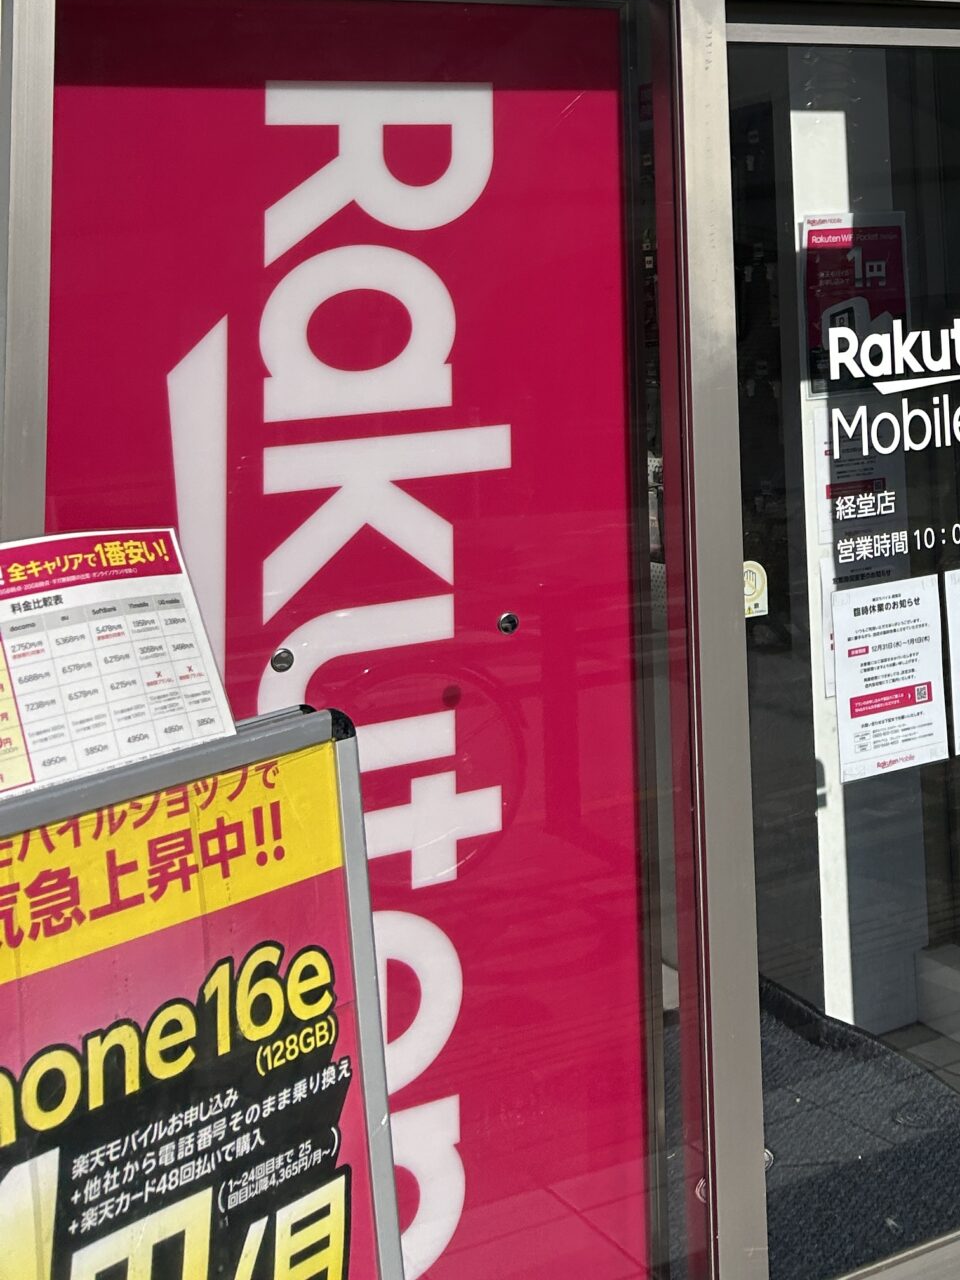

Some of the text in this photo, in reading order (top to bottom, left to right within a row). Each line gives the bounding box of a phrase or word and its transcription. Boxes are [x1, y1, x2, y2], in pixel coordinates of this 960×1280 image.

[811, 234, 841, 244] Rakuten
[836, 490, 896, 521] 経堂店
[837, 530, 909, 564] 営業時間
[10, 594, 64, 614] 料金比較表
[853, 597, 921, 617] 臨時休業のお知らせ
[203, 945, 333, 1056] 16e
[256, 1015, 336, 1076] (128GB)
[72, 1087, 239, 1180] 楽天モバイルお申し込み
[68, 1128, 265, 1235] +楽天カード48回払いで購入
